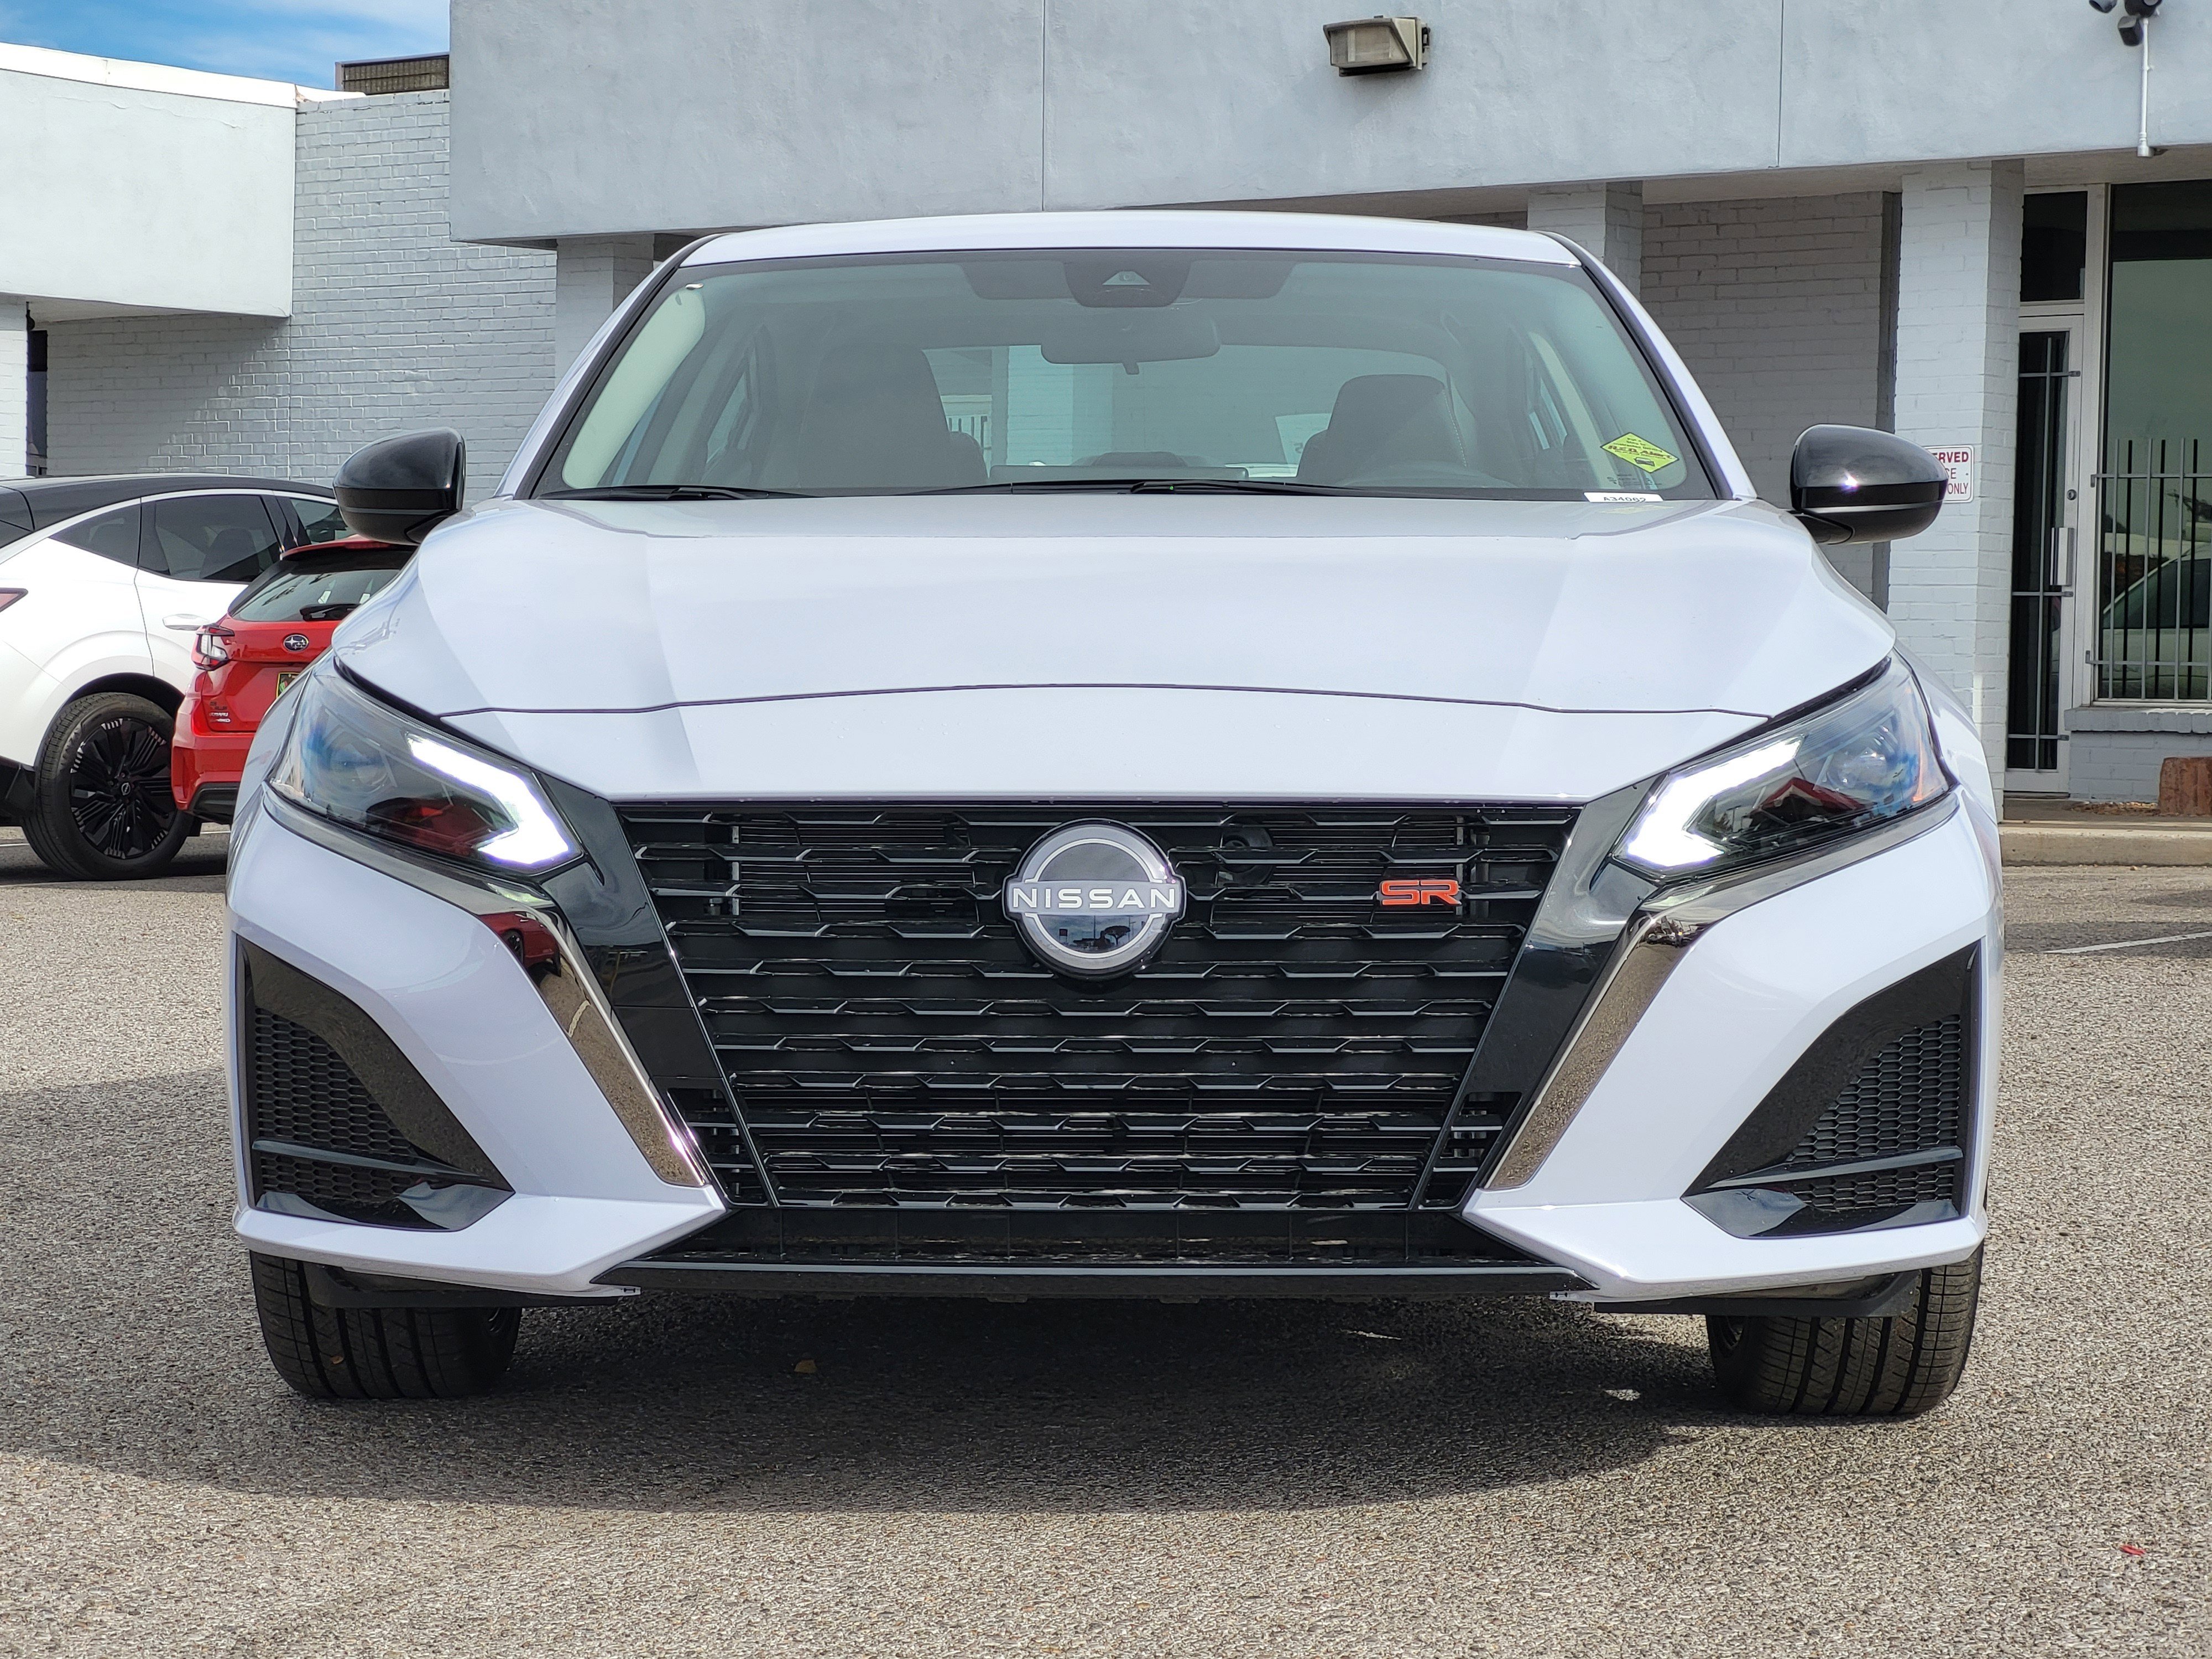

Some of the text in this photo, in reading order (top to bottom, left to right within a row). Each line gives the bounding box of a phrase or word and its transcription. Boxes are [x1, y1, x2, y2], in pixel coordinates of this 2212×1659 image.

[1947, 482, 1969, 495] ONLY
[1013, 888, 1176, 909] NISSAN
[1381, 879, 1462, 905] SR
